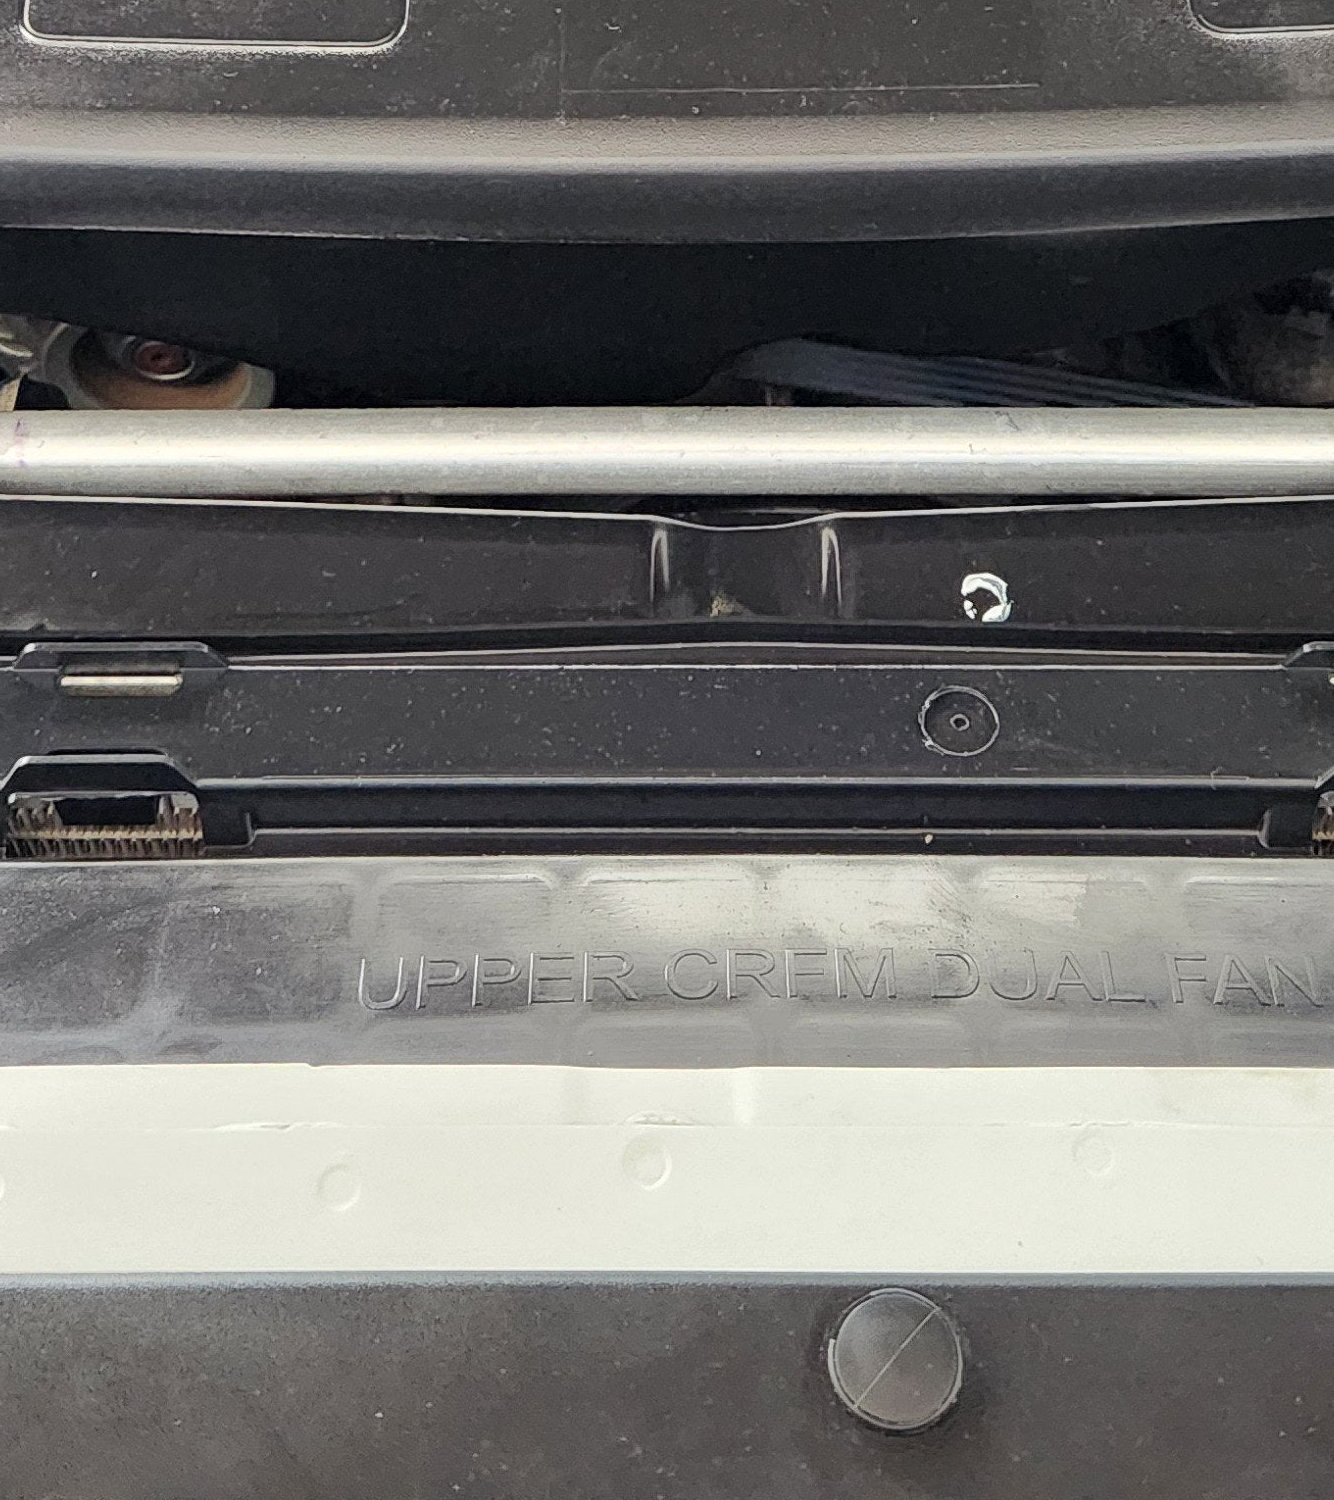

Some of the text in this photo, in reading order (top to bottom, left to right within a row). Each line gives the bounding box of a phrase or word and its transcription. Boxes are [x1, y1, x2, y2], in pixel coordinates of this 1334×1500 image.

[358, 946, 1326, 1010] UPPER CRFM DUAL FAN
